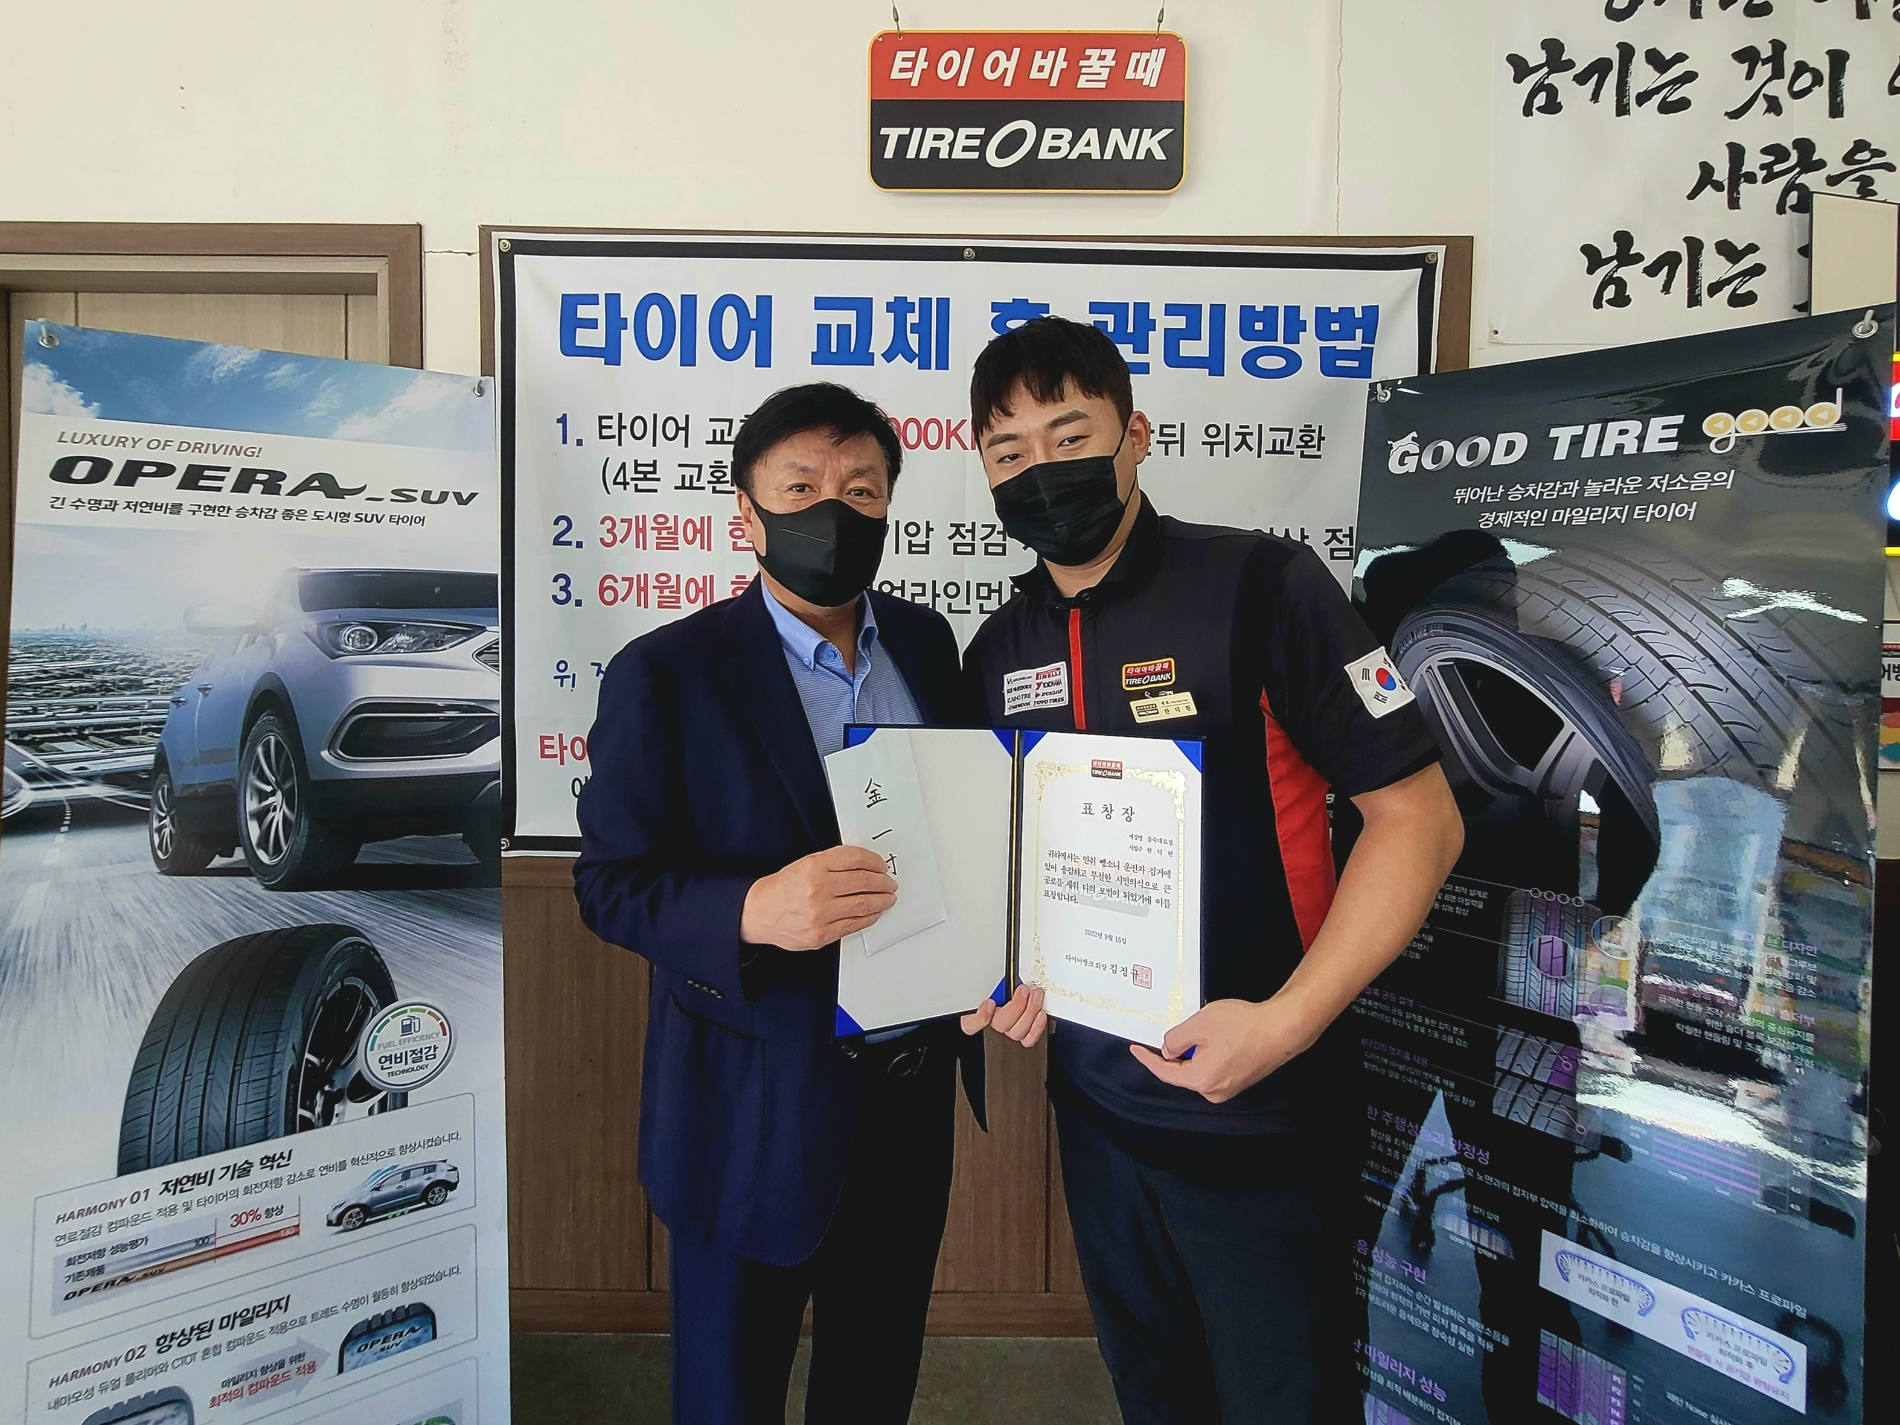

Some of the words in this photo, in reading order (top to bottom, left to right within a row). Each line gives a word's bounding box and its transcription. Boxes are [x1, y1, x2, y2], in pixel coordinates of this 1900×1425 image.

[1505, 38, 1699, 118] 남기는
[1579, 230, 1767, 310] 남기는
[559, 292, 774, 369] 타이어
[810, 295, 951, 371] 교체
[57, 431, 144, 449] LUXURY
[146, 437, 174, 452] OF
[176, 440, 264, 459] DRIVING!
[556, 413, 584, 447] 1.
[597, 412, 690, 448] 타이어
[1146, 421, 1186, 457] 뒤
[1201, 422, 1326, 460] 위치교환
[1387, 431, 1529, 476] GOOD
[1548, 414, 1686, 461] TIRE
[1453, 484, 1505, 505] 뛰어난
[1507, 479, 1581, 502] 승차감과
[1583, 475, 1644, 497] 놀라운
[1646, 469, 1736, 494] 저소음의
[49, 496, 67, 510] 긴
[69, 497, 120, 513] 수명과
[122, 500, 184, 516] 저연비를
[187, 503, 233, 519] 구현한
[235, 505, 279, 521] 승차감
[281, 508, 309, 522] 좋은
[311, 510, 351, 525] 도시형
[353, 512, 386, 525] SUV
[388, 514, 427, 527] 타이어
[1478, 508, 1549, 530] 경제적인
[1551, 503, 1629, 527] 마일리지
[1631, 501, 1698, 523] 타이어
[552, 514, 584, 549] 2.
[598, 513, 713, 552] 3개월에
[551, 573, 583, 608] 3.
[598, 572, 715, 610] 6개월에
[377, 1040, 398, 1051] FUEL
[378, 1044, 439, 1071] 연비절감
[387, 1063, 430, 1078] TECHNOLOGY
[54, 1223, 103, 1248] 연료절감
[106, 1212, 154, 1234] 컴파운드
[155, 1203, 180, 1218] 적용
[181, 1200, 193, 1215] 및
[196, 1188, 240, 1209] 타이어의
[242, 1177, 284, 1196] 회전저항
[286, 1169, 317, 1187] 감소로
[318, 1160, 348, 1178] 연비를
[350, 1147, 397, 1168] 혁신적으로
[55, 1197, 128, 1225] HARMONY
[129, 1189, 151, 1206] 01
[158, 1168, 216, 1197] 저연비
[218, 1159, 255, 1182] 기술
[258, 1149, 294, 1172] 혁신
[229, 1206, 262, 1229] 30%
[264, 1203, 285, 1219] 향상
[341, 1294, 370, 1315] 수명이
[400, 1264, 463, 1294] 향상되었습니다.
[48, 1354, 123, 1390] HARMONY
[124, 1344, 148, 1364] 02
[154, 1318, 216, 1355] 향상된
[218, 1294, 292, 1331] 마일리지
[356, 1325, 424, 1354] OPERA
[208, 1387, 245, 1410] 최적의
[246, 1372, 293, 1396] 컴파운드
[294, 1361, 318, 1379] 적용
[220, 1370, 259, 1390] 마일리지
[288, 1351, 307, 1368] 위한
